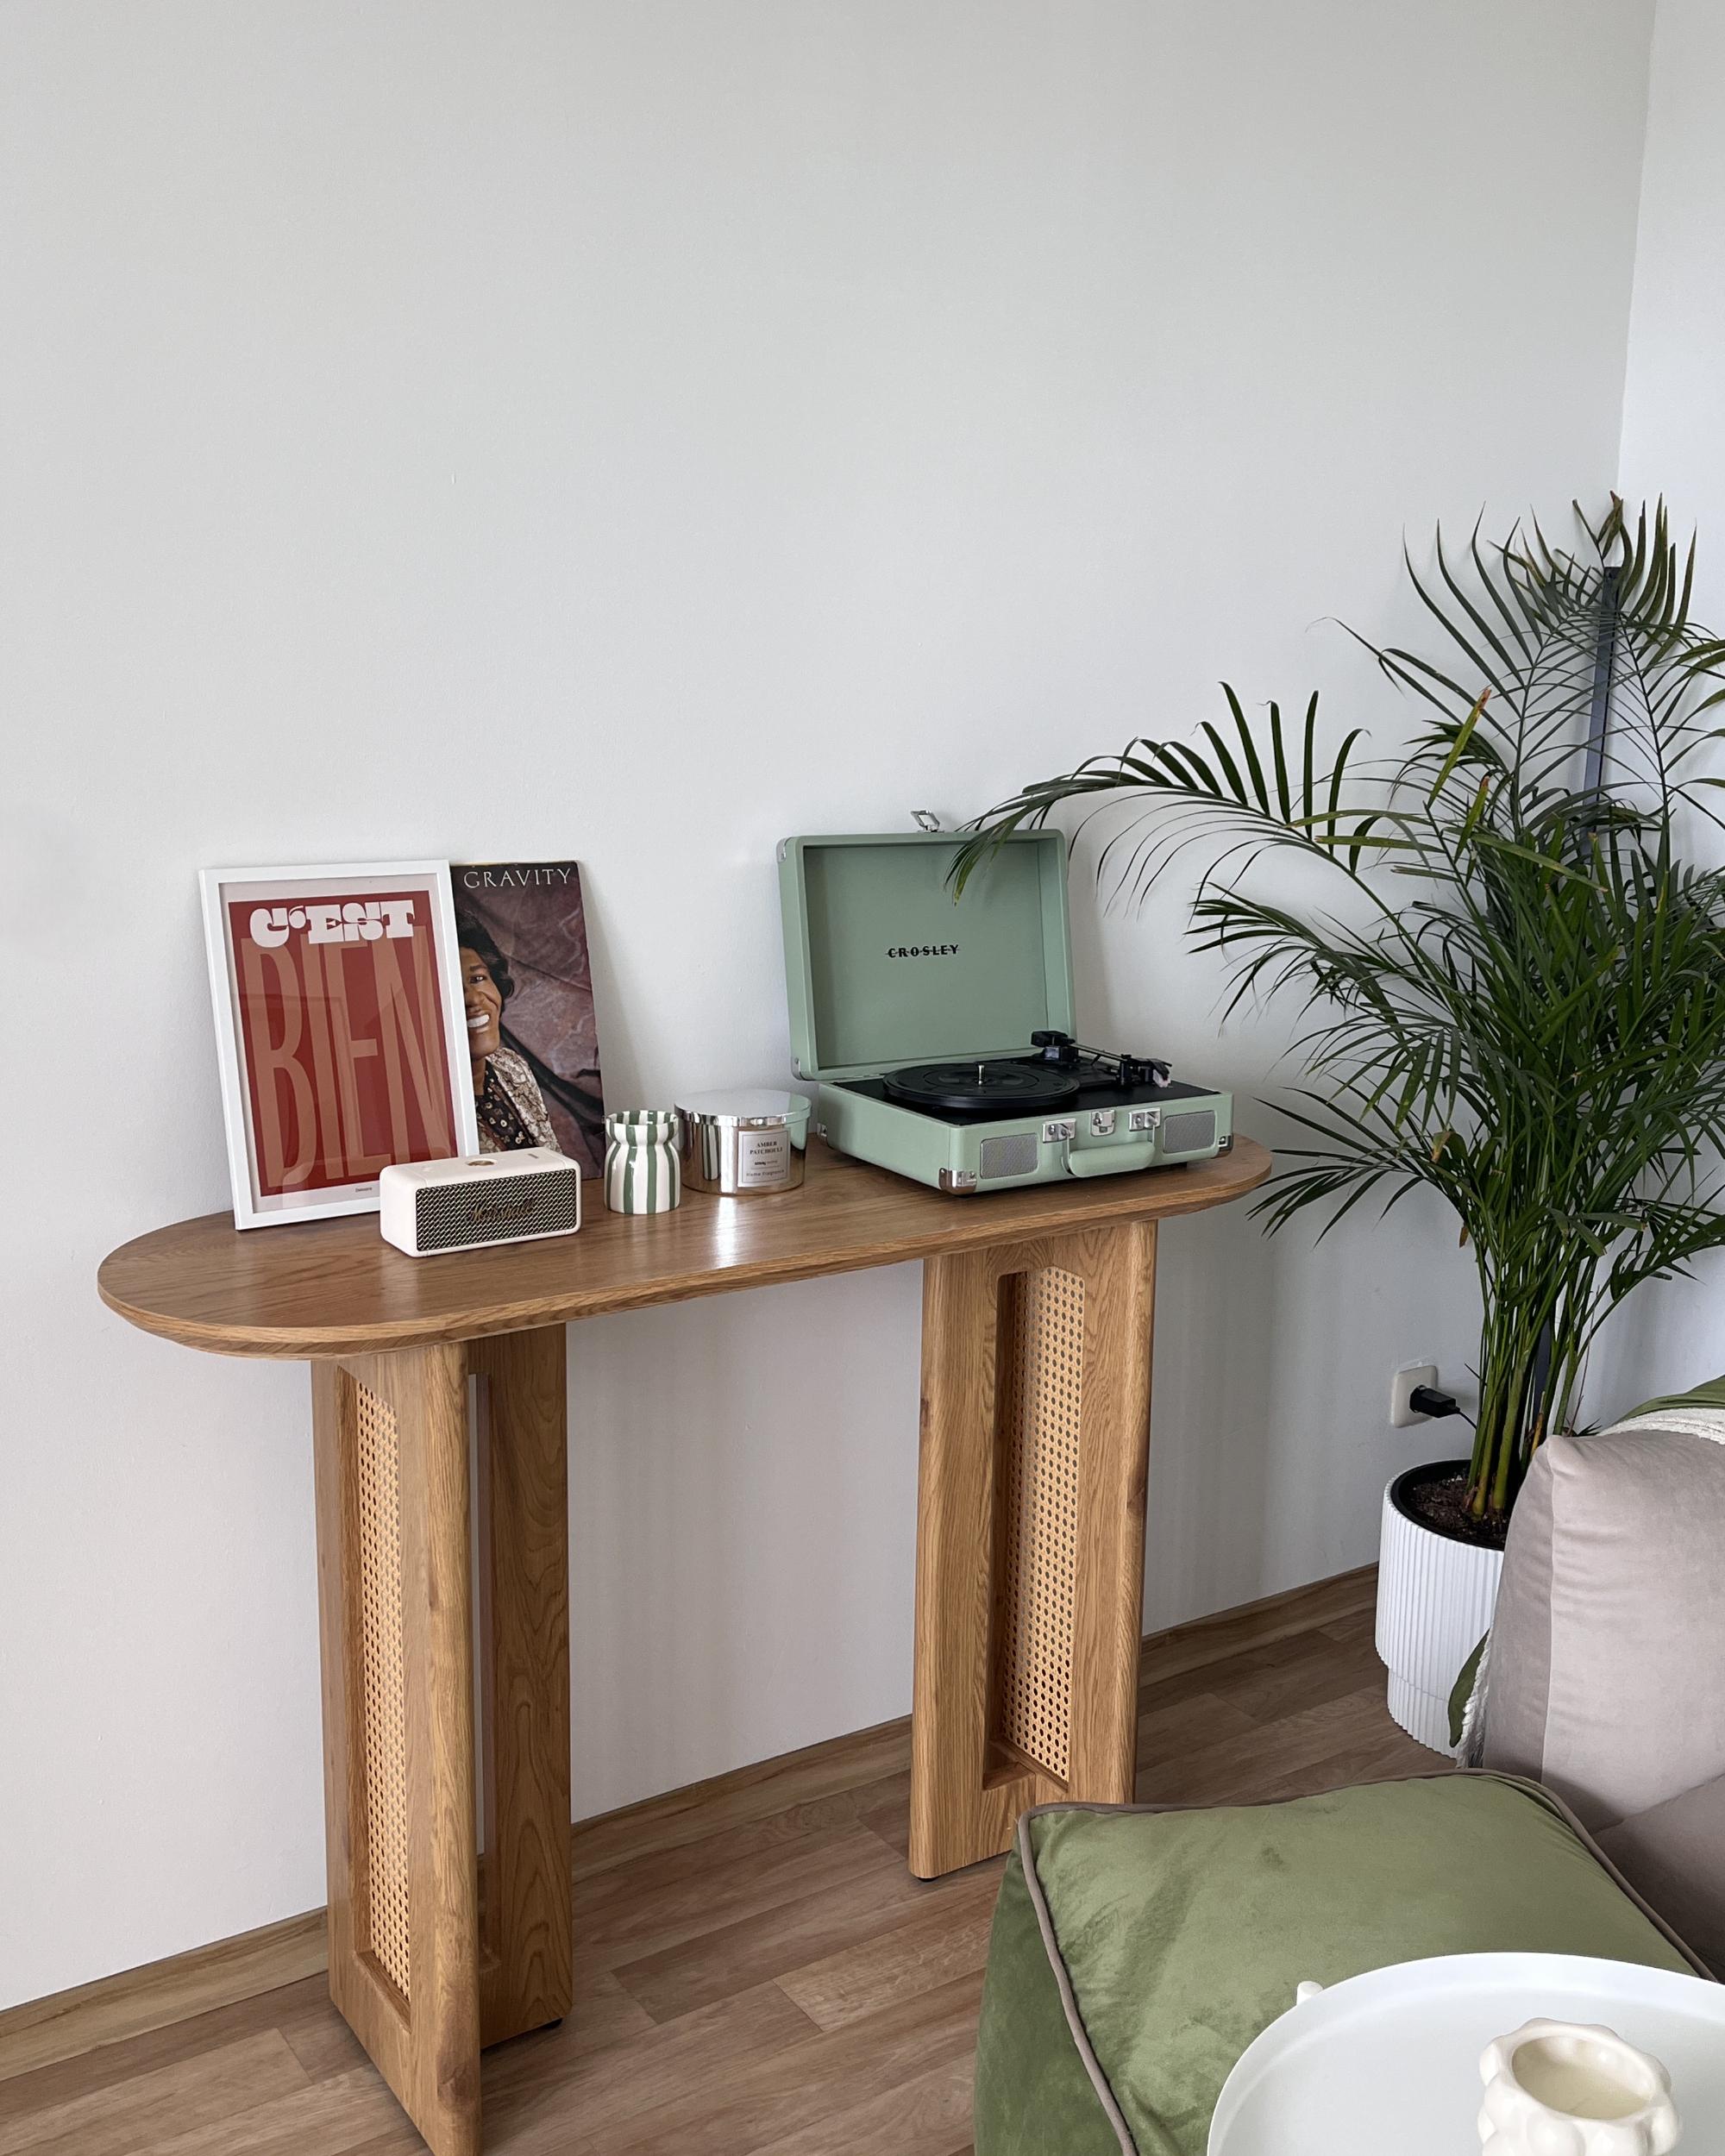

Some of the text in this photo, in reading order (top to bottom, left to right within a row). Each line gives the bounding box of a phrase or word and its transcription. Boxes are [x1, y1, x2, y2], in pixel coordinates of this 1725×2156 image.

[463, 868, 571, 888] GRAVITY
[887, 944, 959, 958] CROSLEY
[241, 926, 451, 1187] BIEN
